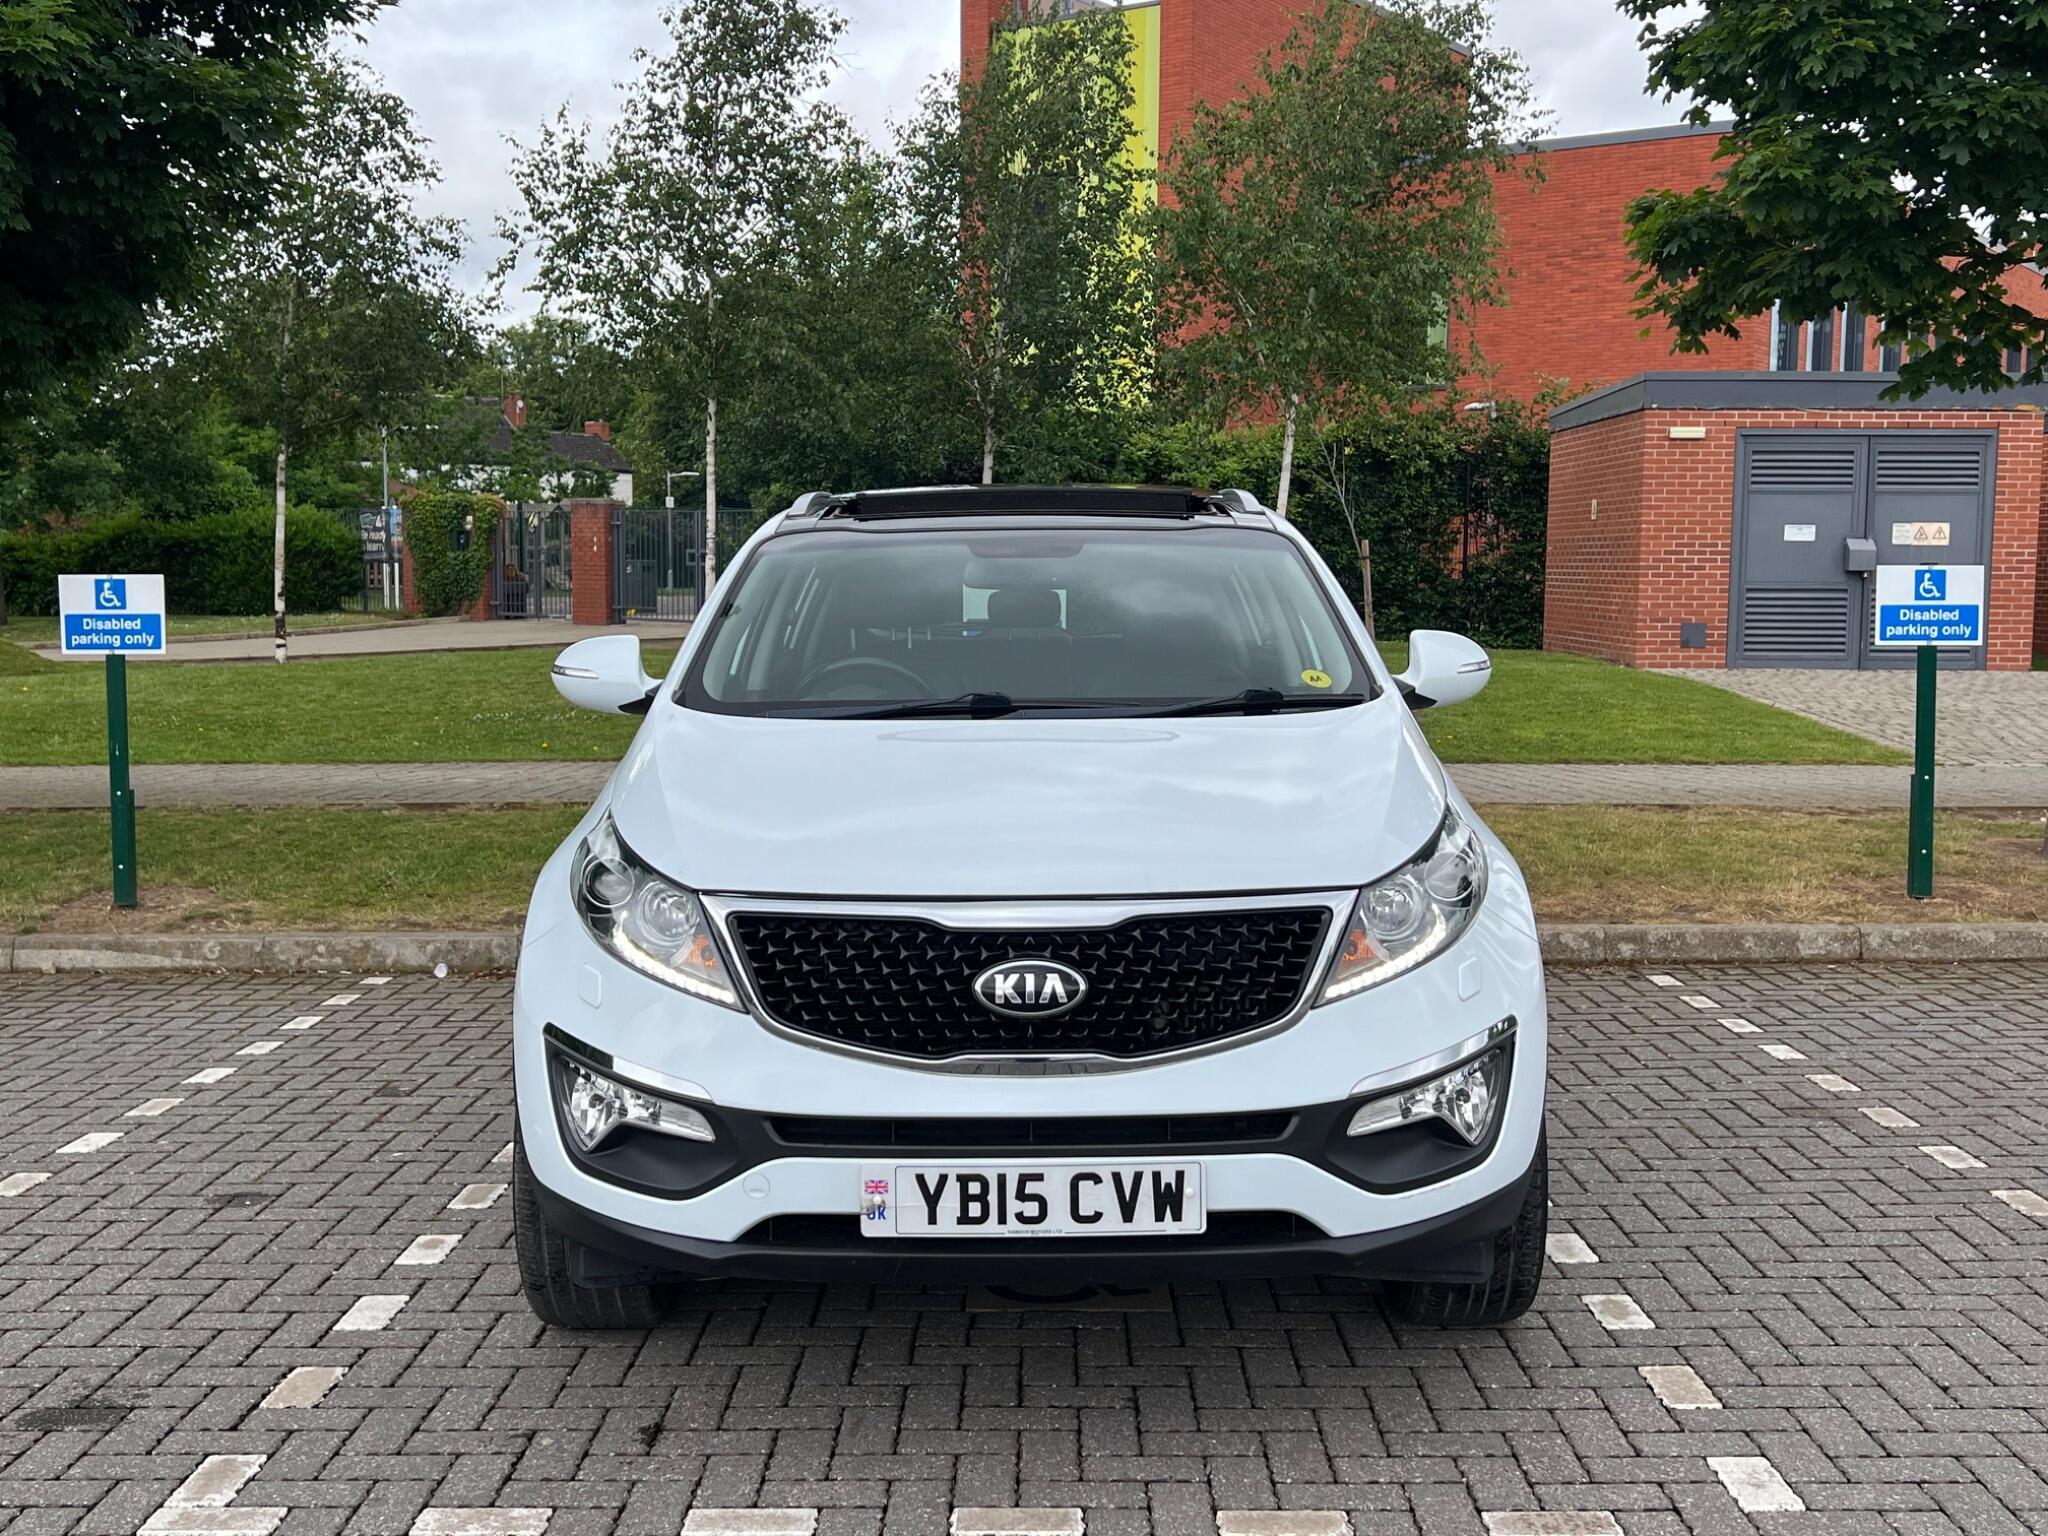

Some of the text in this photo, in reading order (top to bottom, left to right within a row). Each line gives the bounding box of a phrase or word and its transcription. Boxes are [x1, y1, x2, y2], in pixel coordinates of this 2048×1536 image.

[1900, 608, 1959, 621] Disabled
[83, 618, 141, 630] Disabled
[1886, 623, 1972, 638] parking only
[72, 632, 154, 647] parking only
[994, 973, 1068, 1004] KIA
[915, 1170, 1185, 1226] YB15 CVW
[866, 1205, 886, 1220] UK
